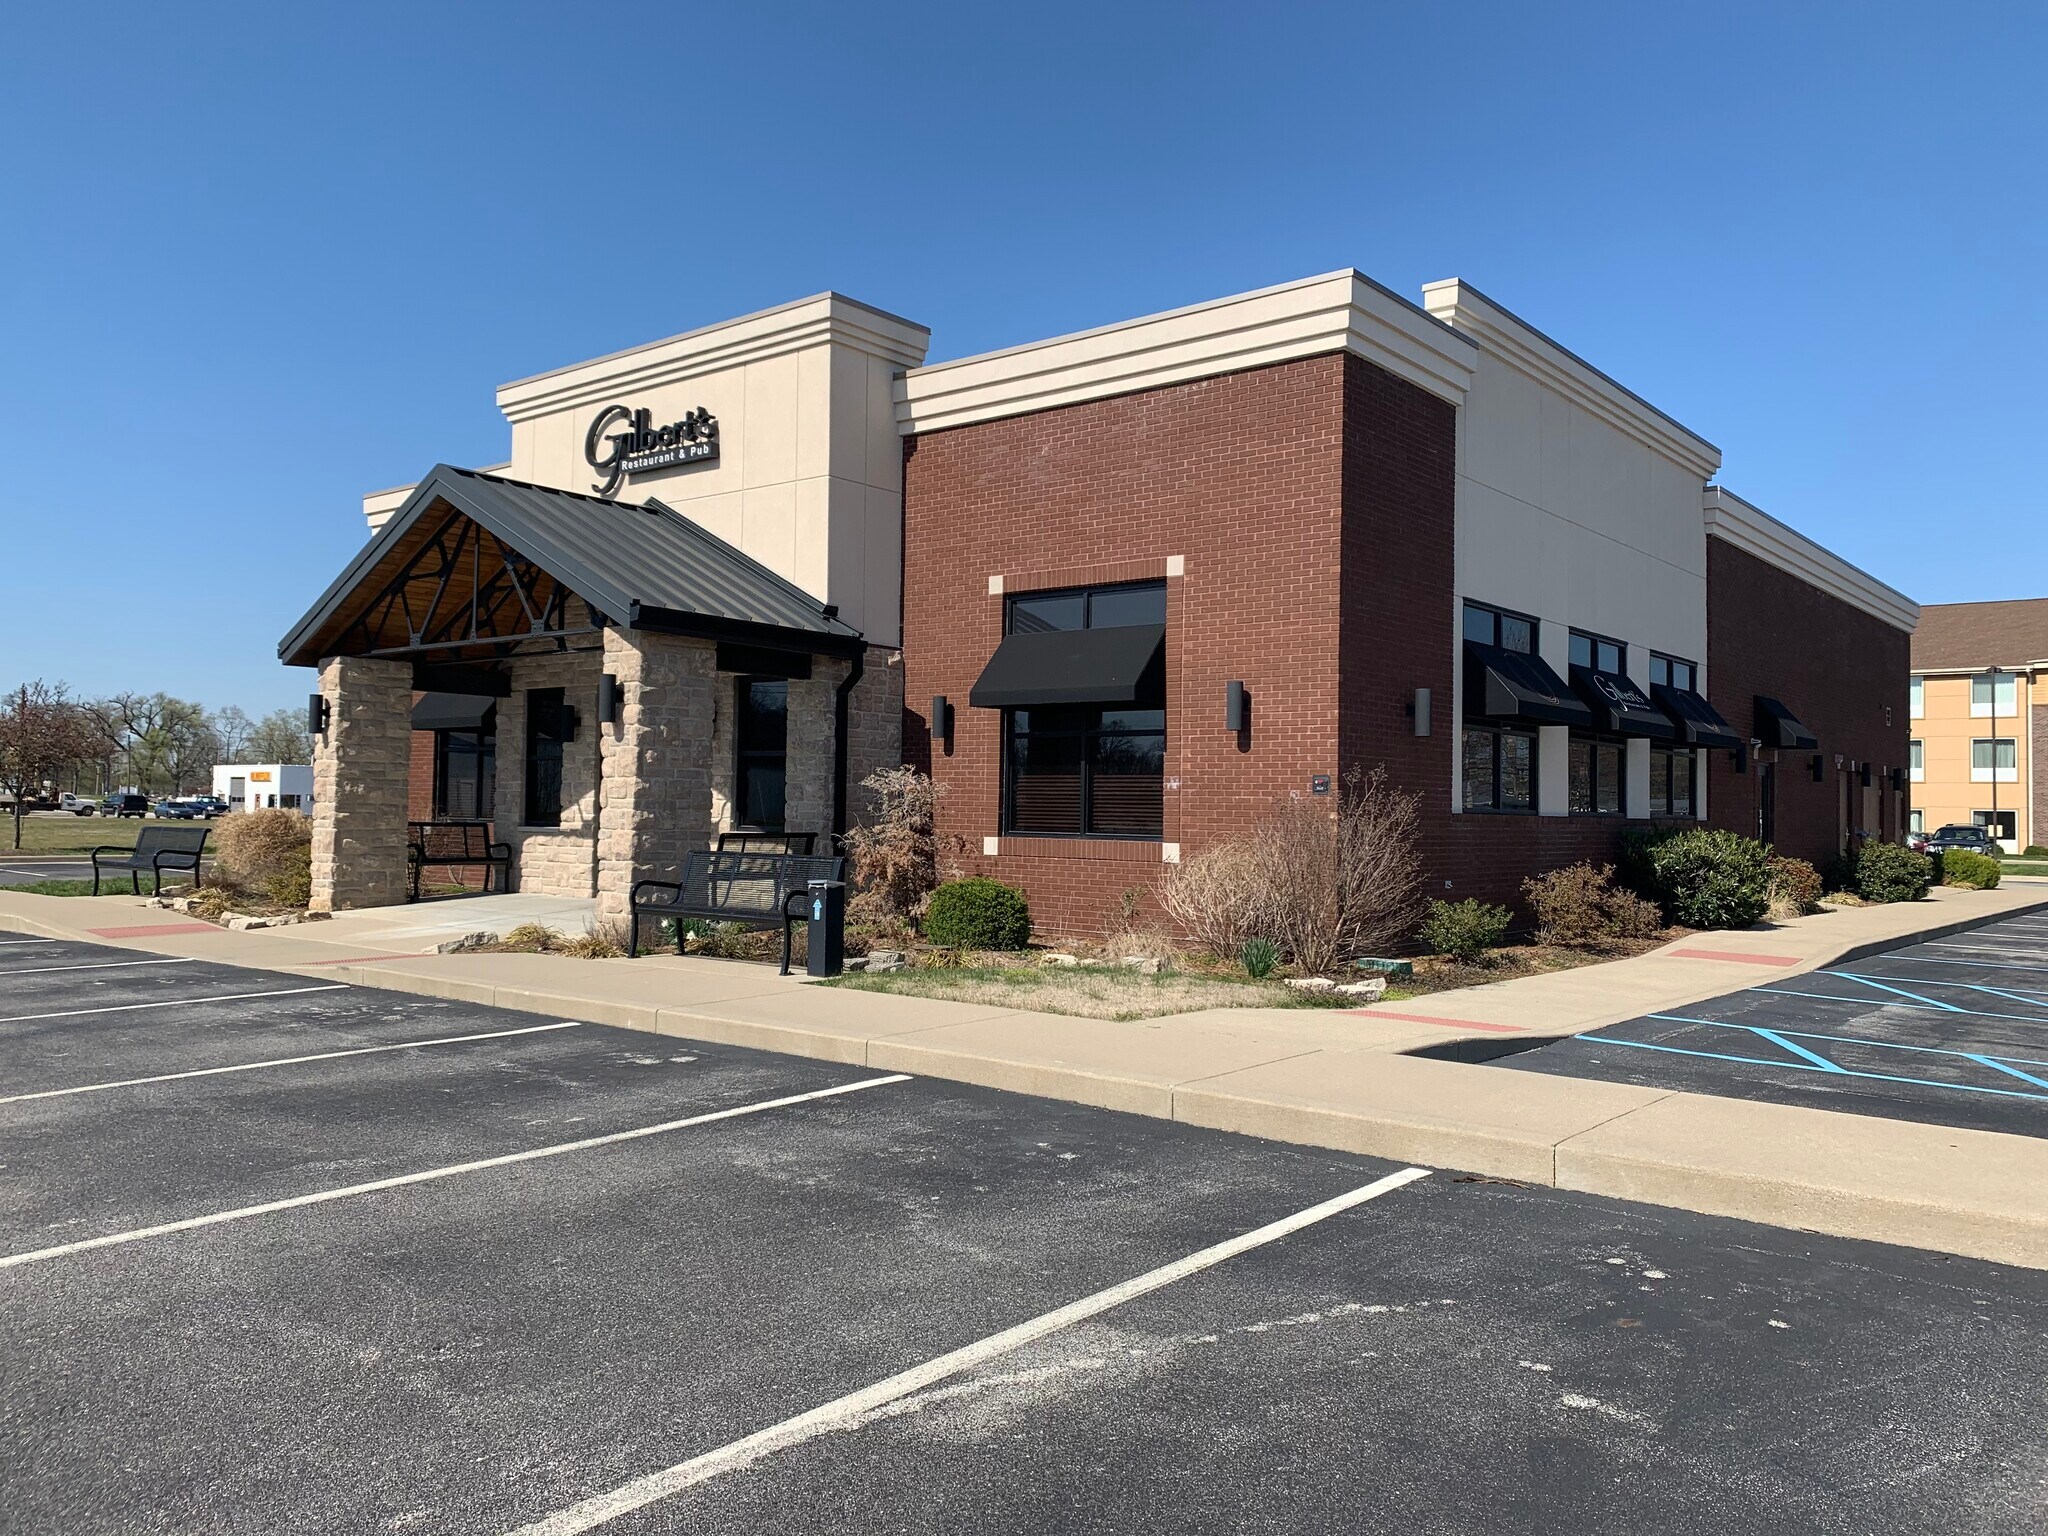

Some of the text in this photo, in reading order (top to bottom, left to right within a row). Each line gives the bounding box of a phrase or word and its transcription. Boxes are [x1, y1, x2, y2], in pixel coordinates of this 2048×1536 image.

[585, 405, 717, 495] Gilbert's
[621, 444, 709, 471] Restaurant & Pub
